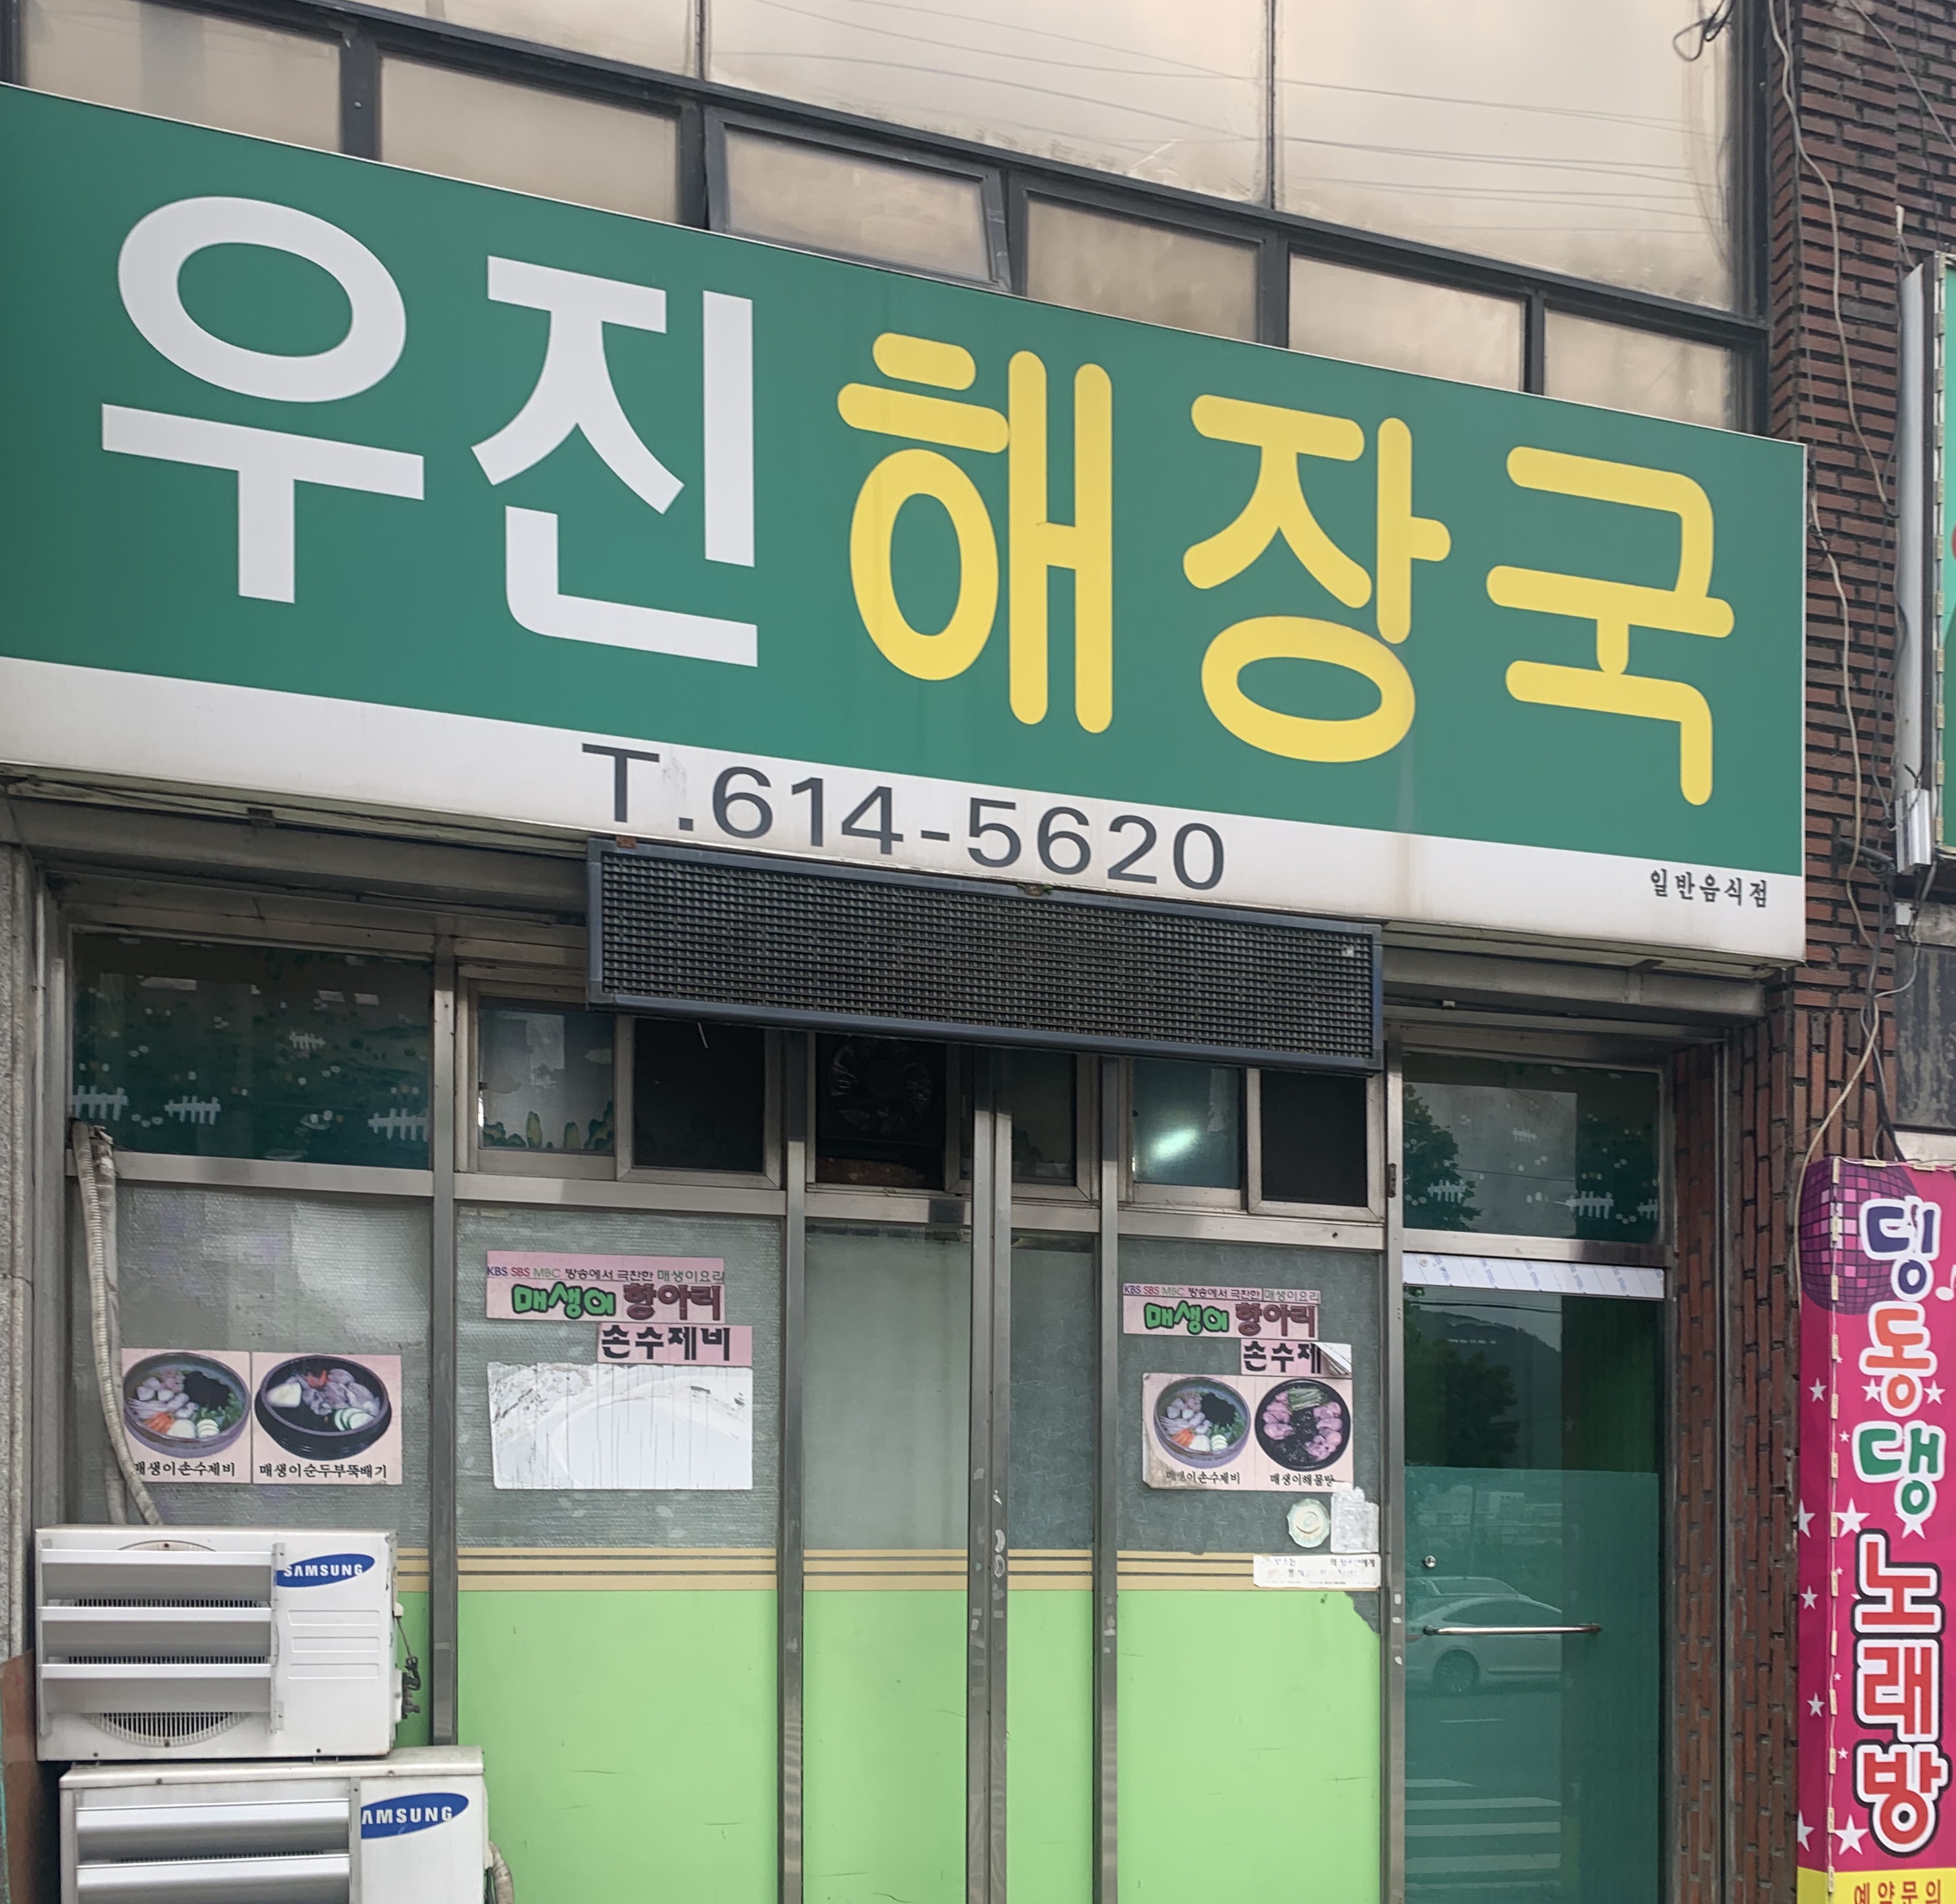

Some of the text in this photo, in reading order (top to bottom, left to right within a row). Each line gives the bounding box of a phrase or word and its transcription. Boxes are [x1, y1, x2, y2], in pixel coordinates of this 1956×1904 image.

[102, 196, 1734, 805] 우진 해장국
[1650, 867, 1768, 908] 일반음식점
[487, 1266, 725, 1283] KBS SBS MBC 방송에서 극찬한 매생이요리
[1124, 1284, 1141, 1294] KBS
[1143, 1285, 1160, 1295] SBS
[1162, 1286, 1184, 1297] MBC
[1188, 1286, 1228, 1299] 방송에서
[1231, 1288, 1260, 1300] 극찬한
[511, 1281, 722, 1321] 매생이 항아리
[1144, 1300, 1316, 1337] 매생이 항아리
[601, 1324, 730, 1361] 손수제비
[1244, 1340, 1322, 1374] 손수제
[1853, 1197, 1945, 1521] 딩동댕
[259, 1463, 388, 1479] 매생이순두부뚝배기
[283, 1563, 363, 1577] SAMSUNG
[1854, 1533, 1948, 1853] 노래방
[361, 1806, 453, 1825] AMSUNG
